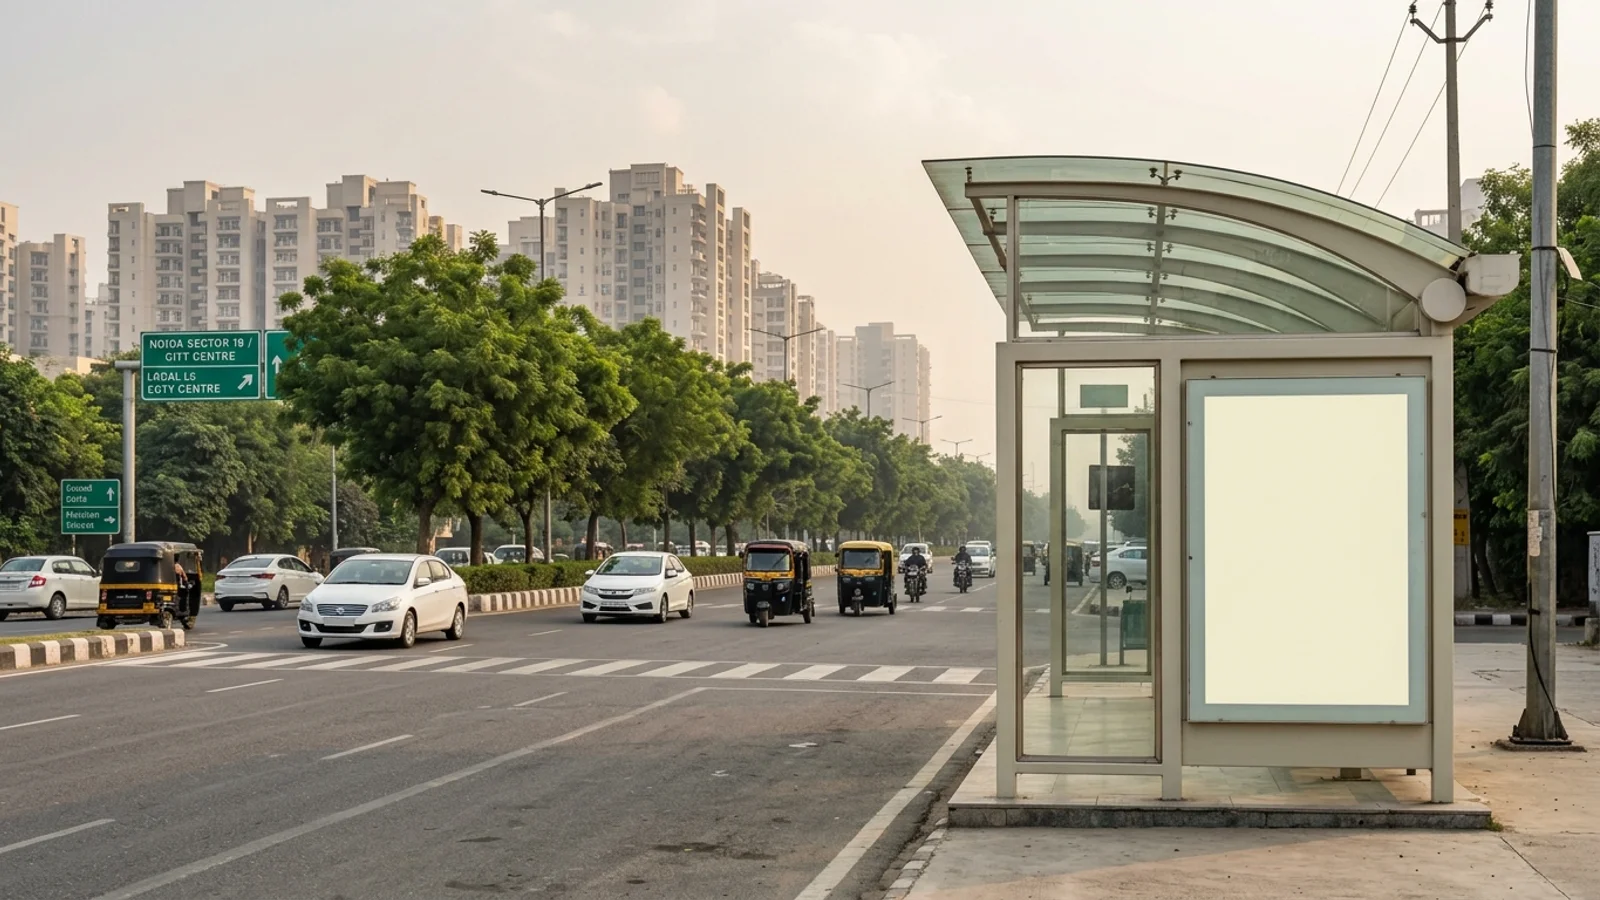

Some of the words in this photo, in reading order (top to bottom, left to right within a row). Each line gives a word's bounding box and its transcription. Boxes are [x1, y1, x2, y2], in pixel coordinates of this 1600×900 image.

[187, 338, 229, 348] SECTOR
[192, 351, 236, 361] CENTRE
[177, 384, 221, 394] CENTRE
